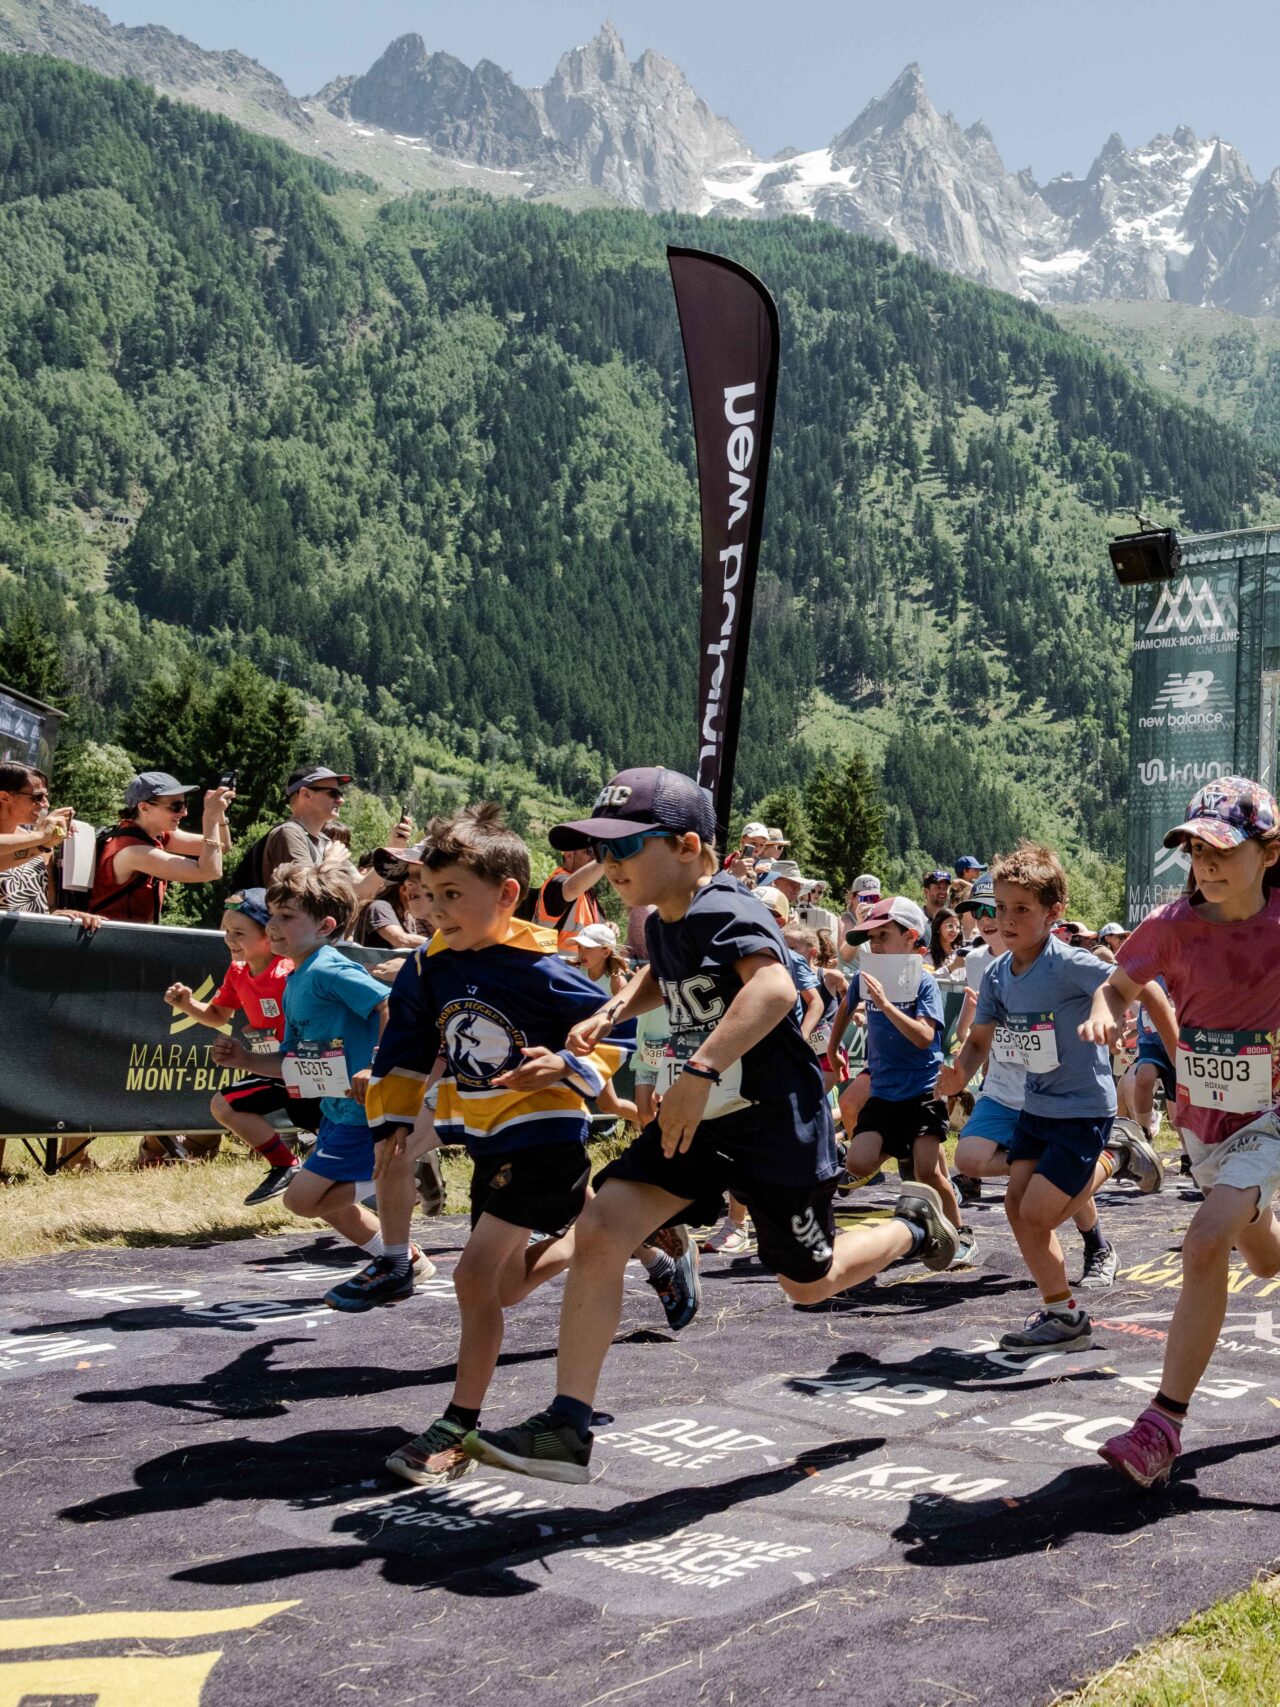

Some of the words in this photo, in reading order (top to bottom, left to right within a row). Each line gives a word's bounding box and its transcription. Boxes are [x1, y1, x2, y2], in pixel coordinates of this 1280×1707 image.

[1138, 717, 1165, 728] new
[1167, 711, 1223, 726] balance
[1170, 757, 1221, 780] i-run
[1129, 883, 1186, 904] MARAT
[658, 974, 726, 1025] HC
[1014, 1033, 1041, 1051] 329
[129, 1043, 222, 1068] MARAT
[125, 1067, 251, 1091] MONT-BLAN
[294, 1060, 333, 1077] 15375
[1184, 1056, 1251, 1082] 15303
[1204, 1081, 1230, 1092] ROXANE
[792, 1376, 948, 1417] 42
[631, 1418, 777, 1451] DUO
[832, 1462, 1010, 1501] KM
[659, 1528, 813, 1559] YOUNG
[570, 1550, 732, 1589] MARATHON
[603, 1541, 782, 1577] RACE
